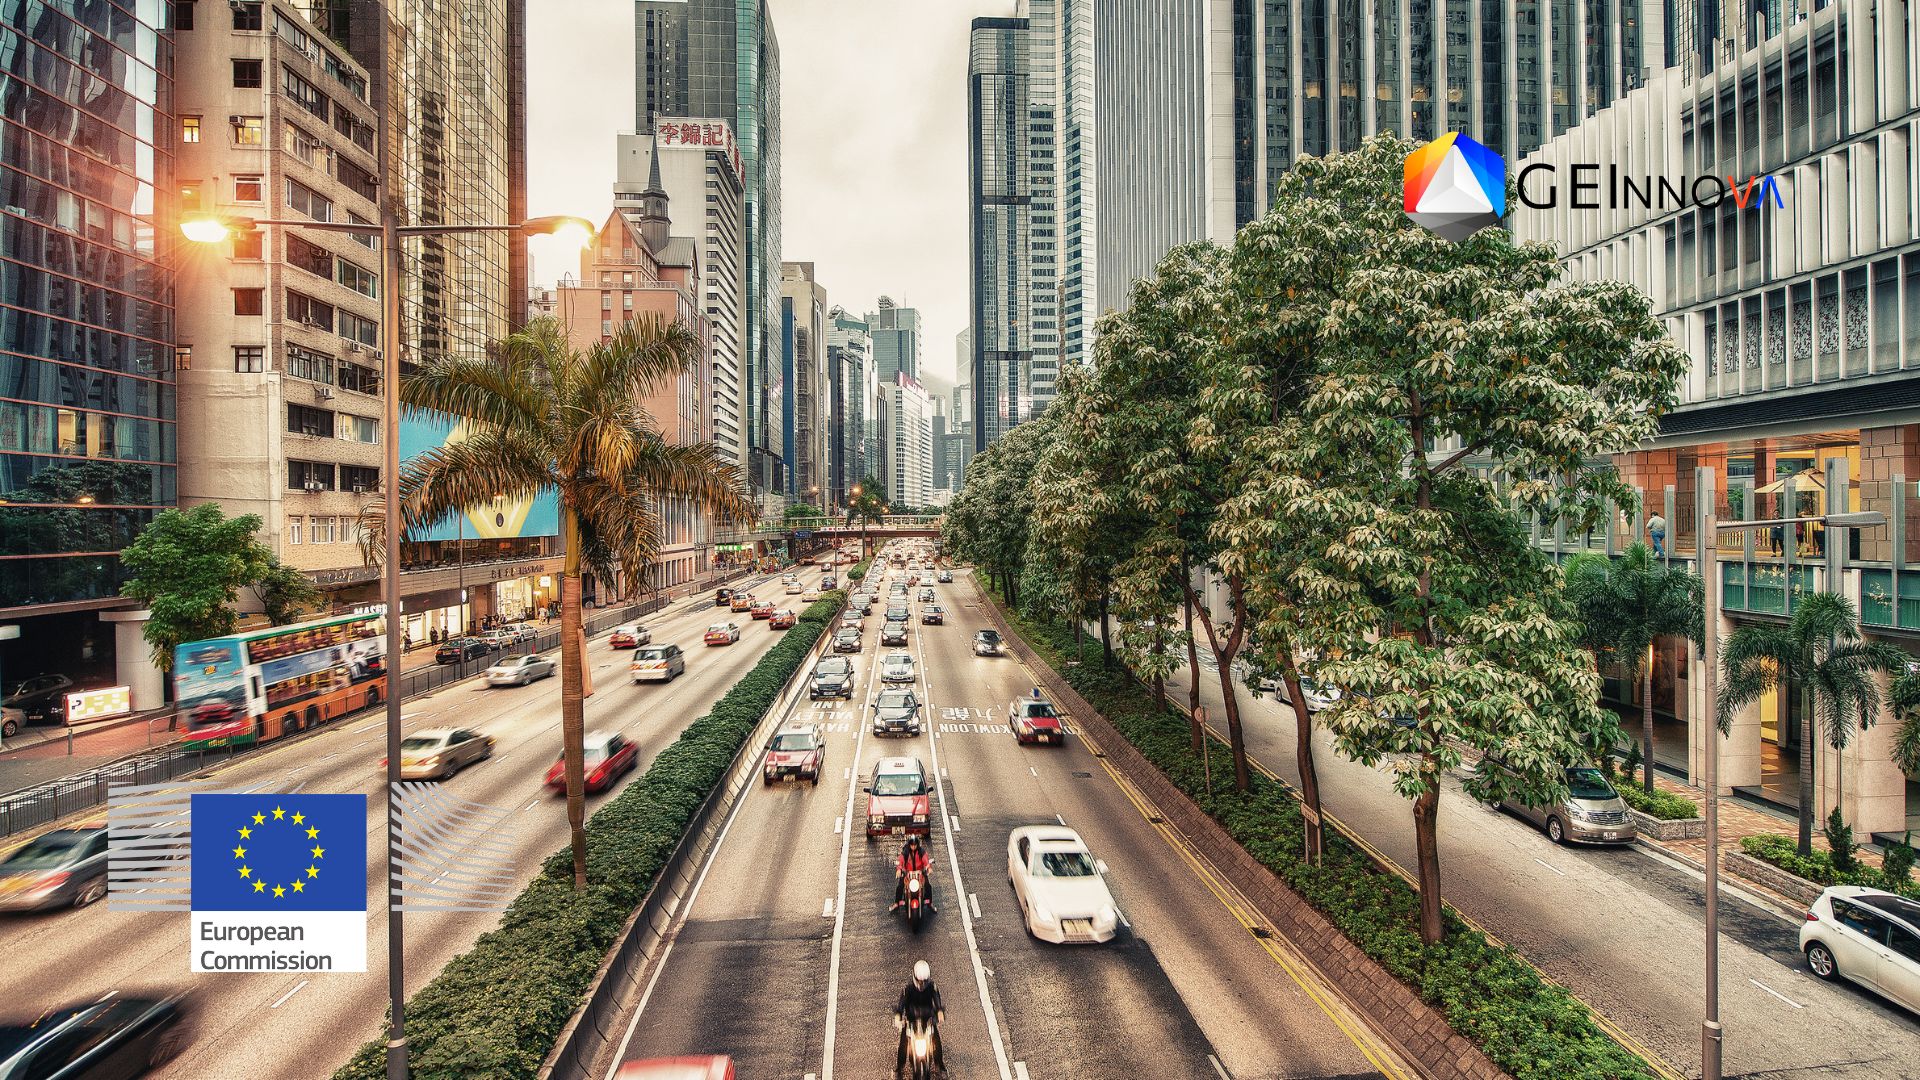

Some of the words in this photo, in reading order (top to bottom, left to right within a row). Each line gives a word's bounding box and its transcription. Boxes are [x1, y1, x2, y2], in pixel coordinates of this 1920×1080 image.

[659, 122, 724, 145] 李錦記
[353, 600, 404, 615] MASERI
[938, 723, 1012, 734] KOWLOON
